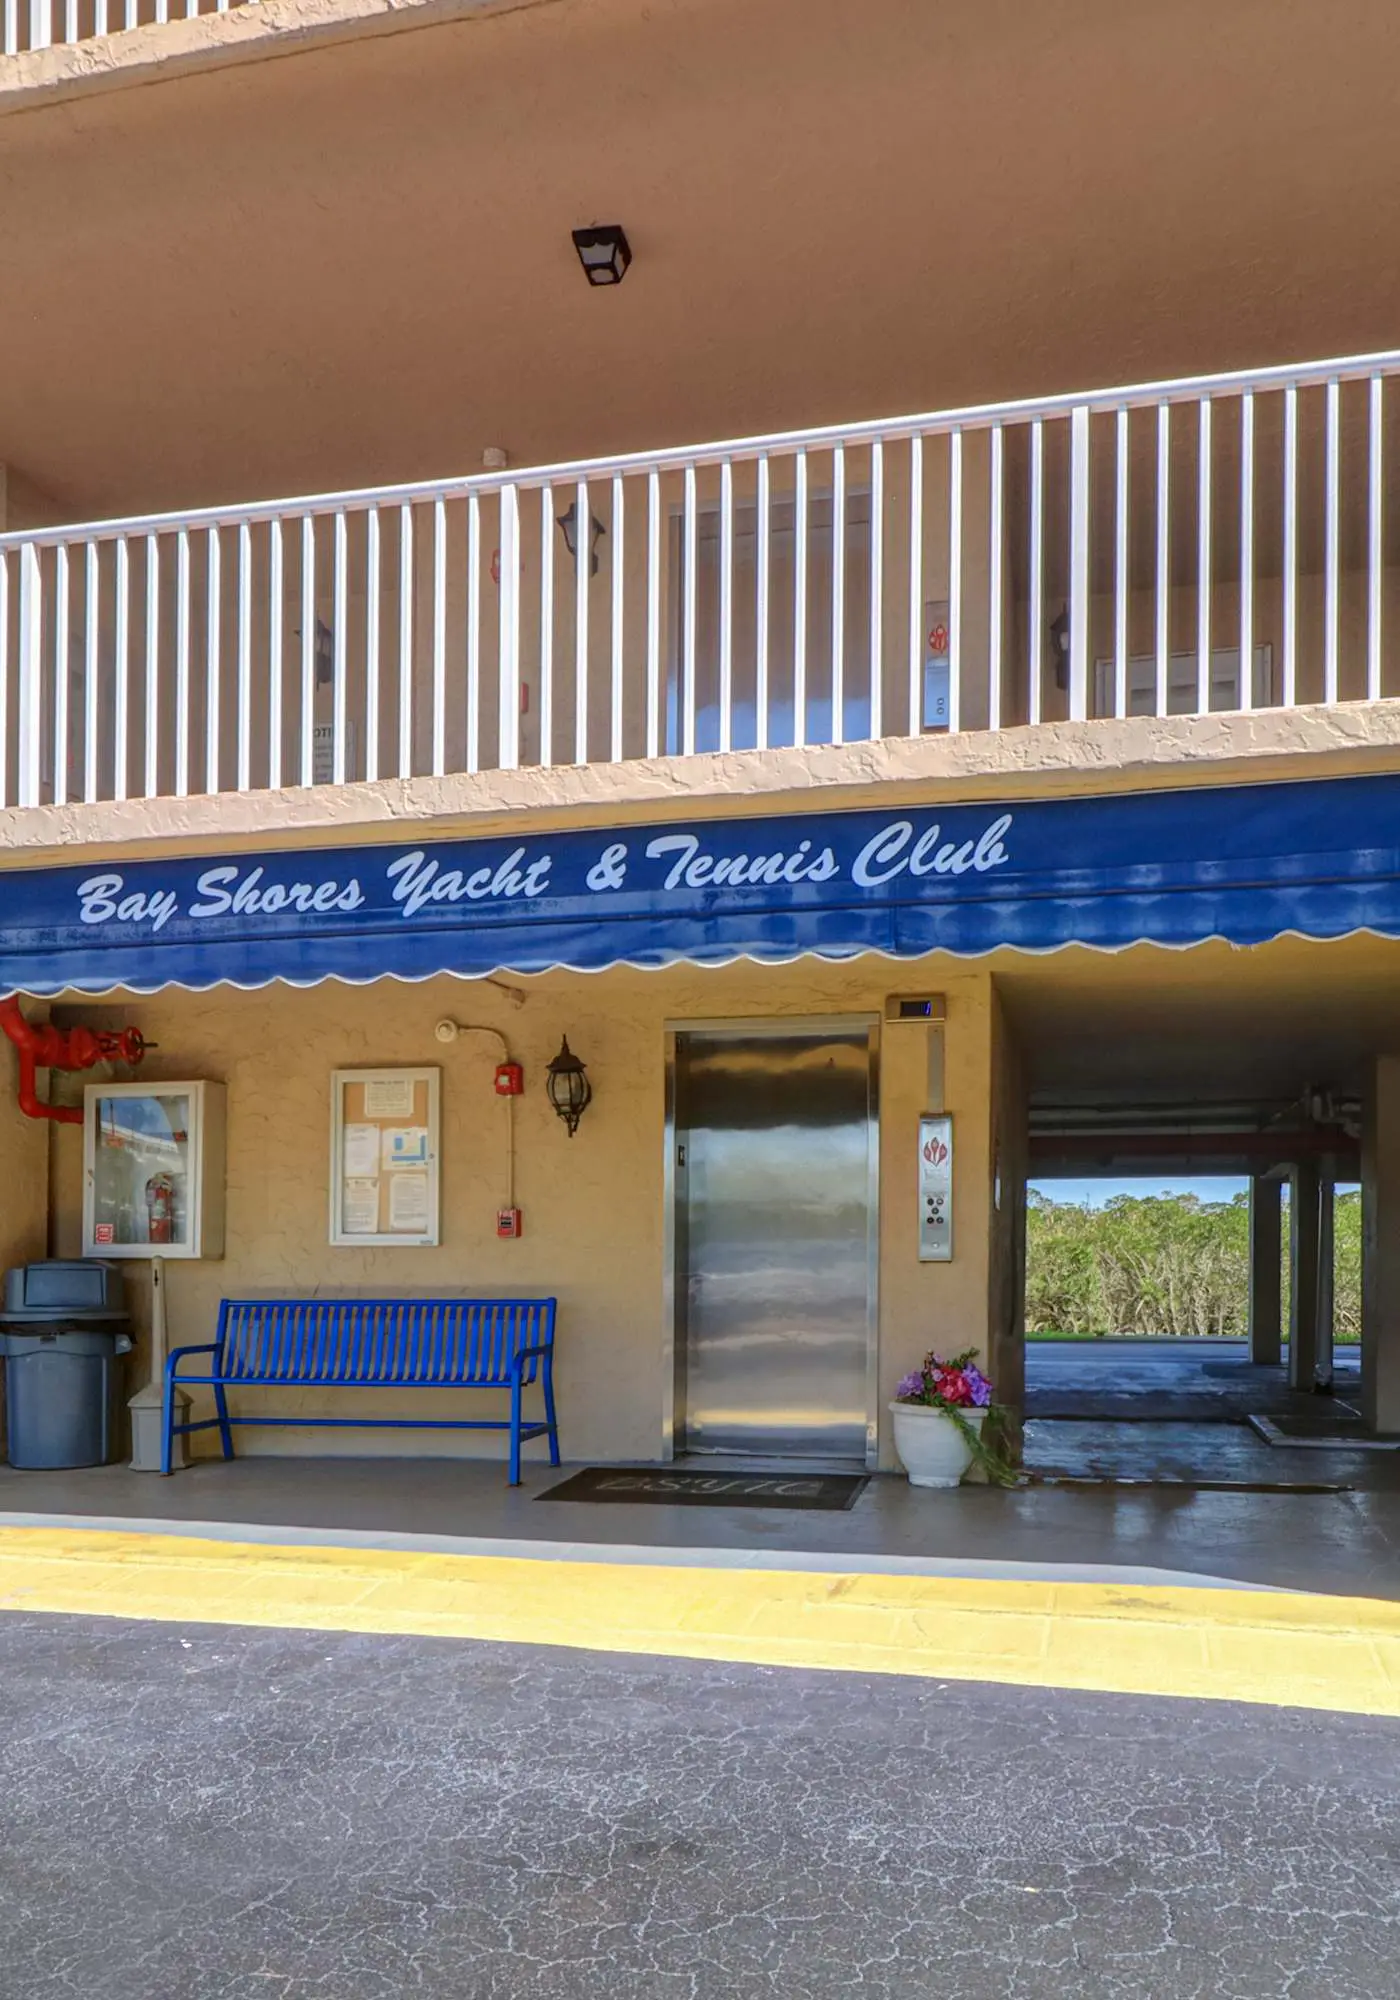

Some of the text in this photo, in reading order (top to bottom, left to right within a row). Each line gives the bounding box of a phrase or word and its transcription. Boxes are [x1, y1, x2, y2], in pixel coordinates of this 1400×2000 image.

[77, 814, 1013, 932] Bay Shores Yacht & Tennis Club
